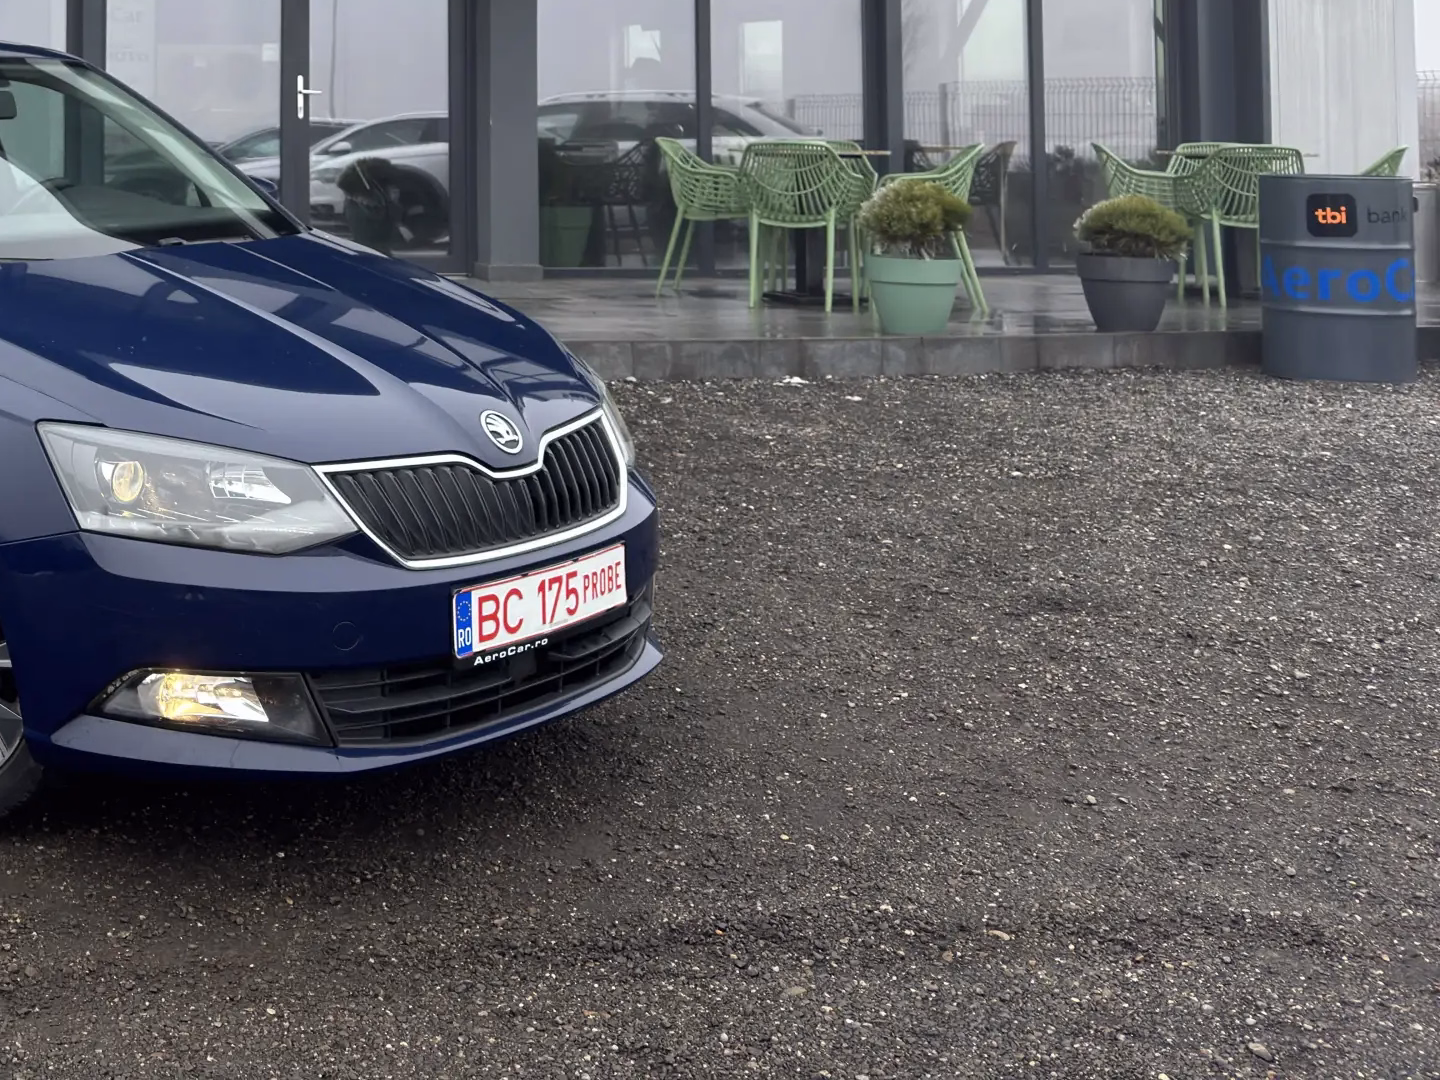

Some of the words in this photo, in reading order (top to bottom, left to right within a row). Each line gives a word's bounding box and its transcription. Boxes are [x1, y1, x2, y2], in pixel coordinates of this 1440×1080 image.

[1314, 206, 1347, 224] tbi
[478, 588, 524, 643] BC
[537, 571, 579, 625] 175
[582, 561, 622, 604] PROBE
[457, 627, 472, 648] RO
[473, 638, 549, 666] AeroCar.ro
